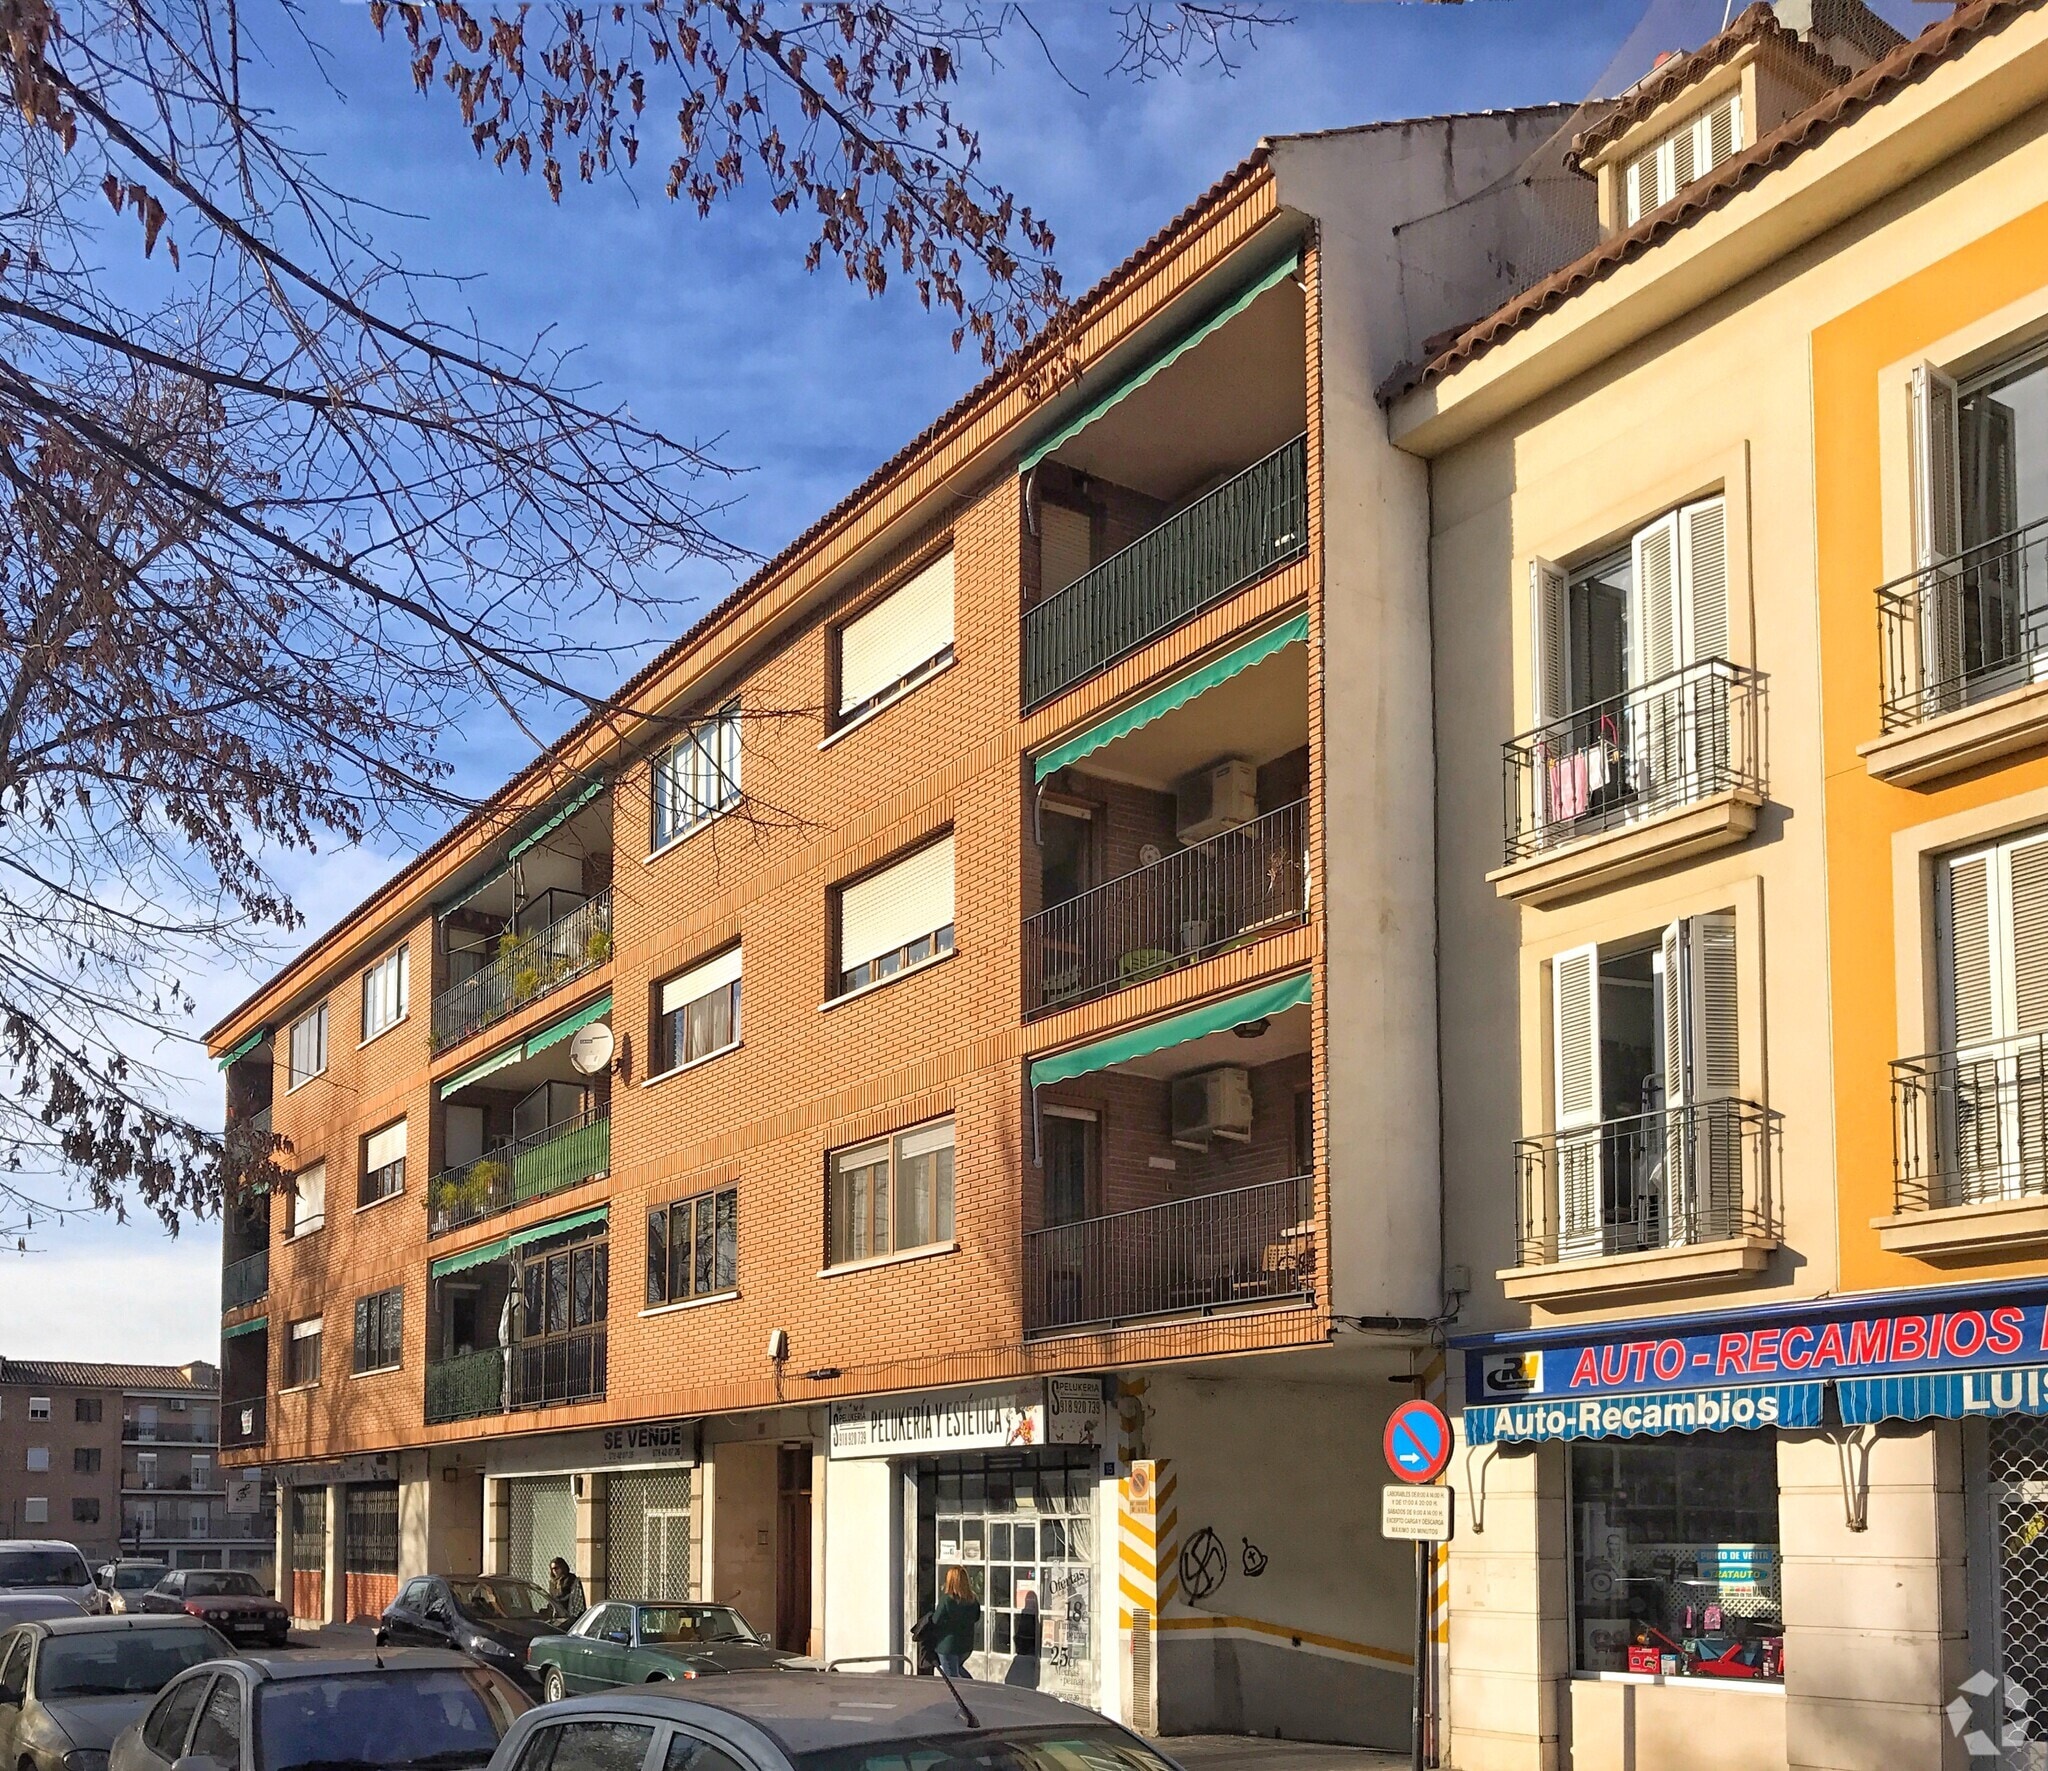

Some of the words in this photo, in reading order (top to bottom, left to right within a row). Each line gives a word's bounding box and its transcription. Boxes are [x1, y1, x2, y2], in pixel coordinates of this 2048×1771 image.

[1963, 1371, 2048, 1410] LUI
[871, 1398, 932, 1443] PELUKERÍA
[935, 1401, 943, 1438] Y
[946, 1393, 1002, 1437] ESTÉTICA
[1493, 1392, 1779, 1437] Auto-Recambios
[604, 1430, 623, 1450] SE
[627, 1427, 681, 1448] VENDE
[1730, 1551, 1740, 1560] DE
[1743, 1551, 1769, 1560] VENTA
[1049, 1569, 1086, 1594] Ofertas
